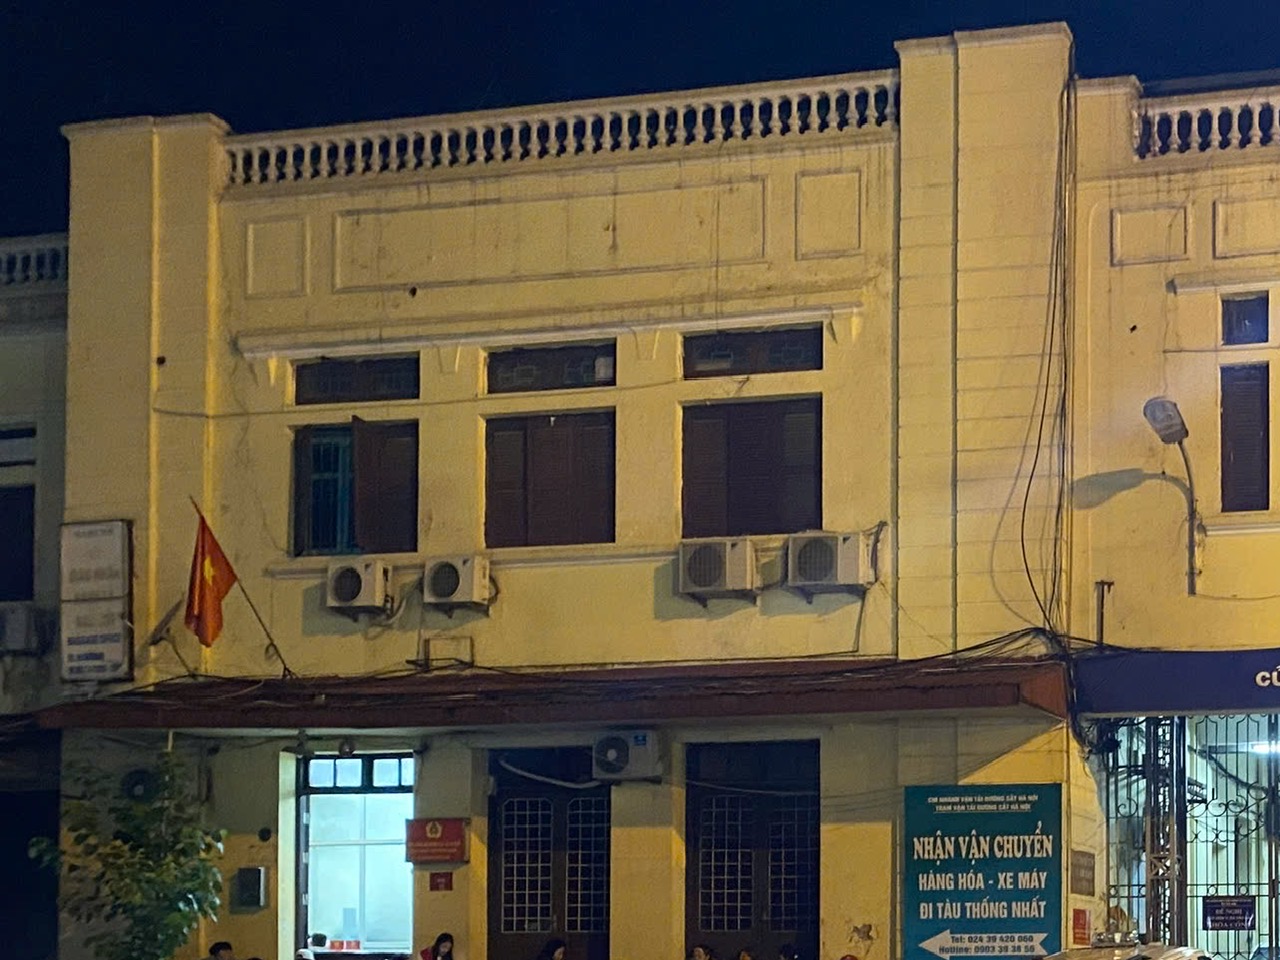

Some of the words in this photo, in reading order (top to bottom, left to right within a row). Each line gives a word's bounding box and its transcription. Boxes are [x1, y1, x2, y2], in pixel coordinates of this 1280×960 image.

[913, 830, 954, 866] NHẬN
[959, 829, 990, 865] VẬN
[994, 821, 1053, 859] CHUYỂN
[919, 870, 954, 891] HÀNG
[958, 869, 985, 890] HÓA
[998, 872, 1014, 889] XE
[1018, 868, 1047, 889] MÁY
[919, 902, 933, 920] ĐI
[936, 899, 961, 919] TÀU
[965, 896, 1008, 919] THỐNG
[1012, 895, 1046, 919] NHẤT
[951, 935, 966, 943] Tel:
[968, 935, 983, 943] 024
